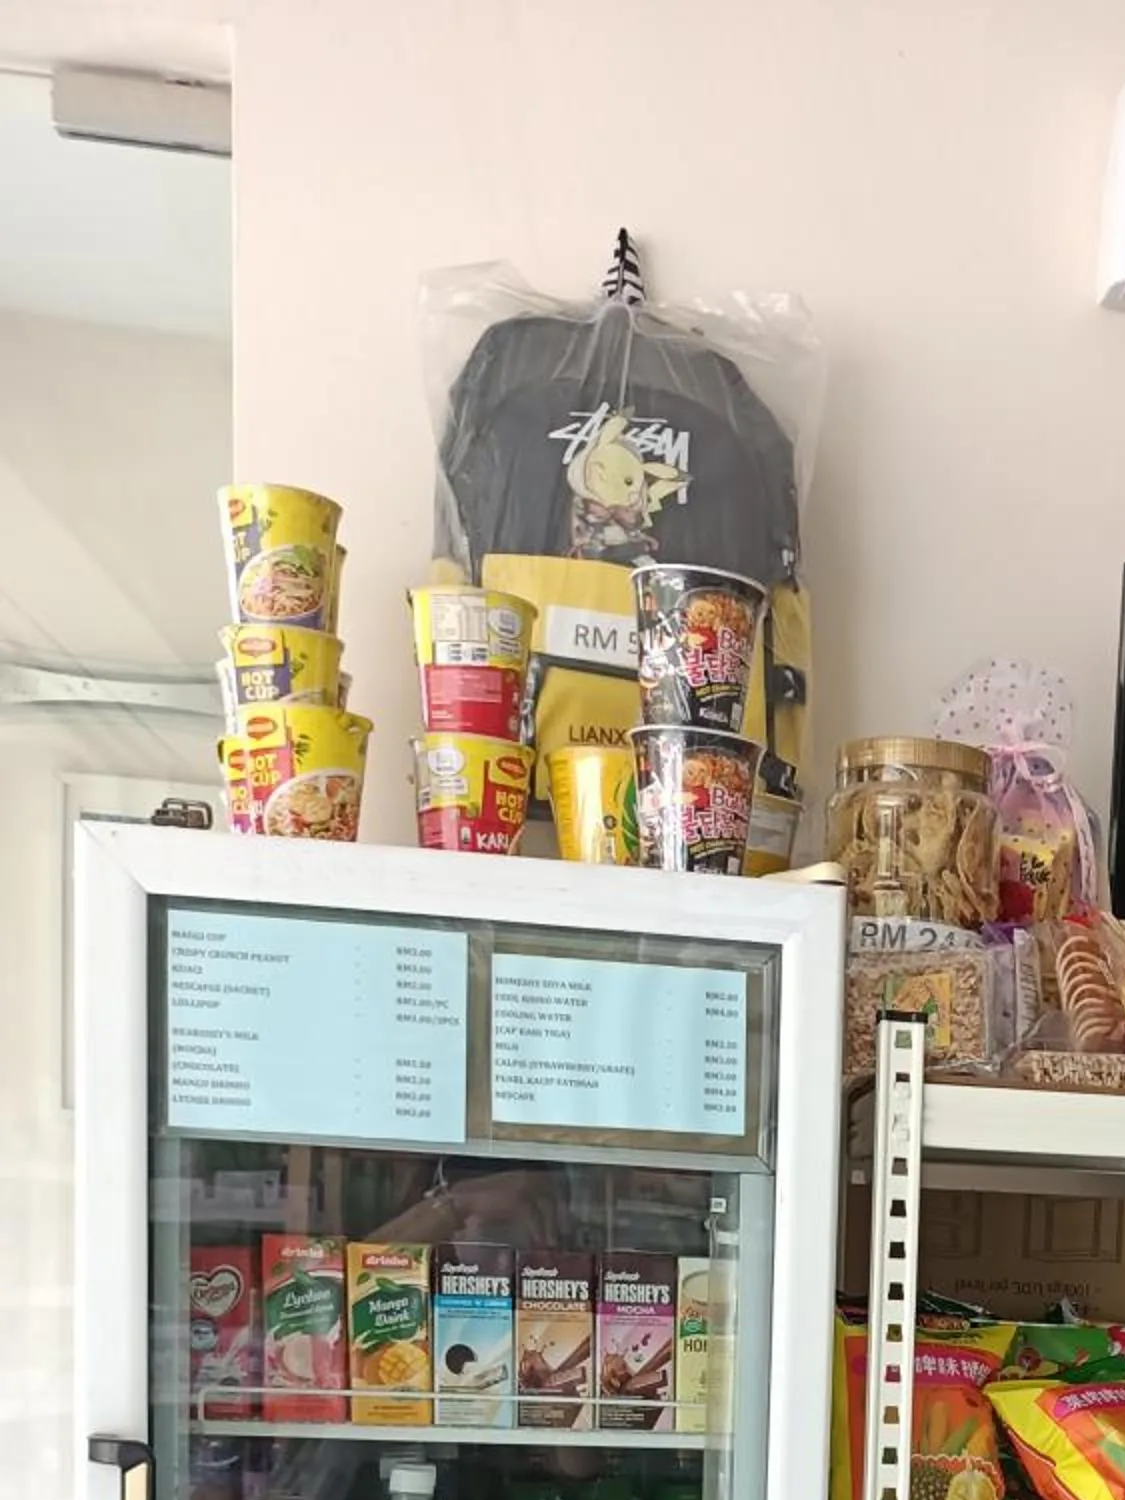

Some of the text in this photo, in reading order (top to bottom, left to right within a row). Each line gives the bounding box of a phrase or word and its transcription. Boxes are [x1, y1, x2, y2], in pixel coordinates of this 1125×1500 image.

[573, 622, 618, 654] RM
[860, 920, 907, 950] RM
[441, 1275, 511, 1297] HERSHEY'S
[521, 1278, 590, 1300] HERSHEY'S
[604, 1283, 671, 1304] HERSHEY'S
